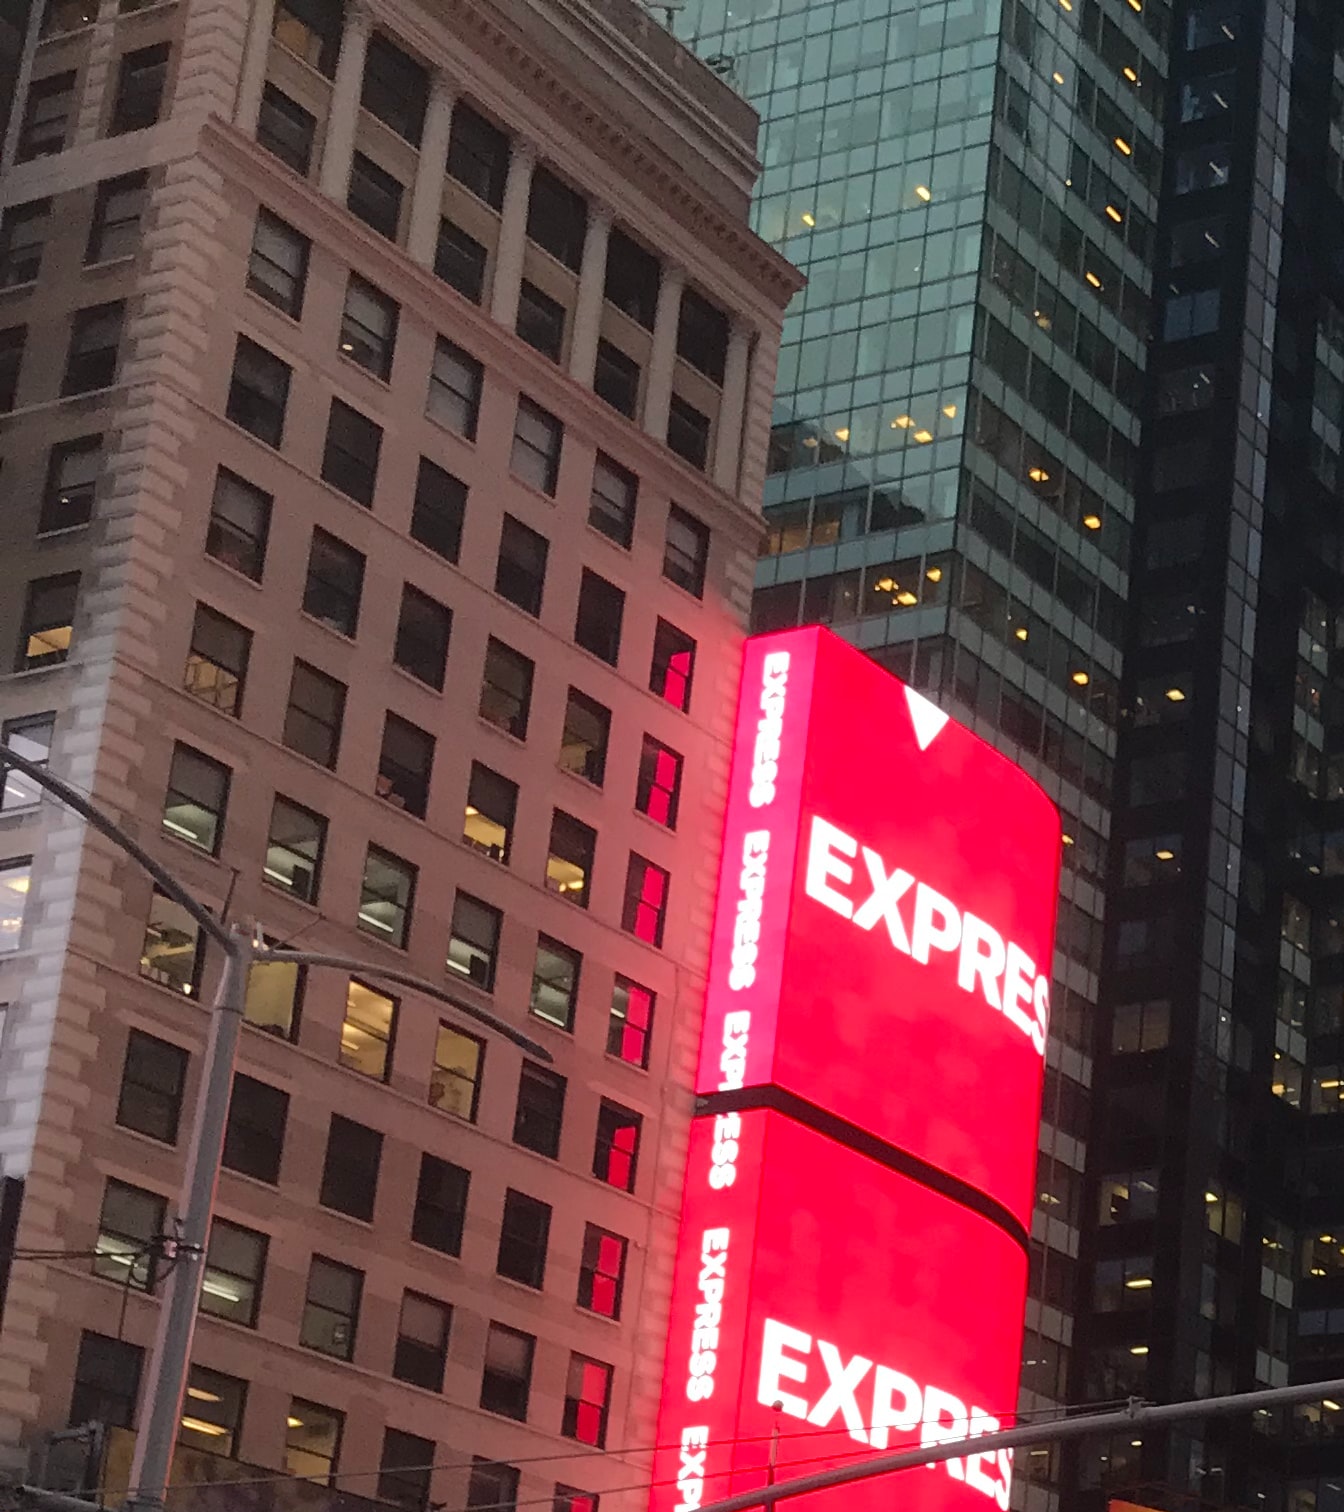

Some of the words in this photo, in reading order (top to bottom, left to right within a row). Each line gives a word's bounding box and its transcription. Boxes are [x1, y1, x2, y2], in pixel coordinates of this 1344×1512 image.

[749, 650, 791, 809] EXPRESS
[728, 829, 771, 993] EXPRESS
[686, 1226, 731, 1403] EXPRESS
